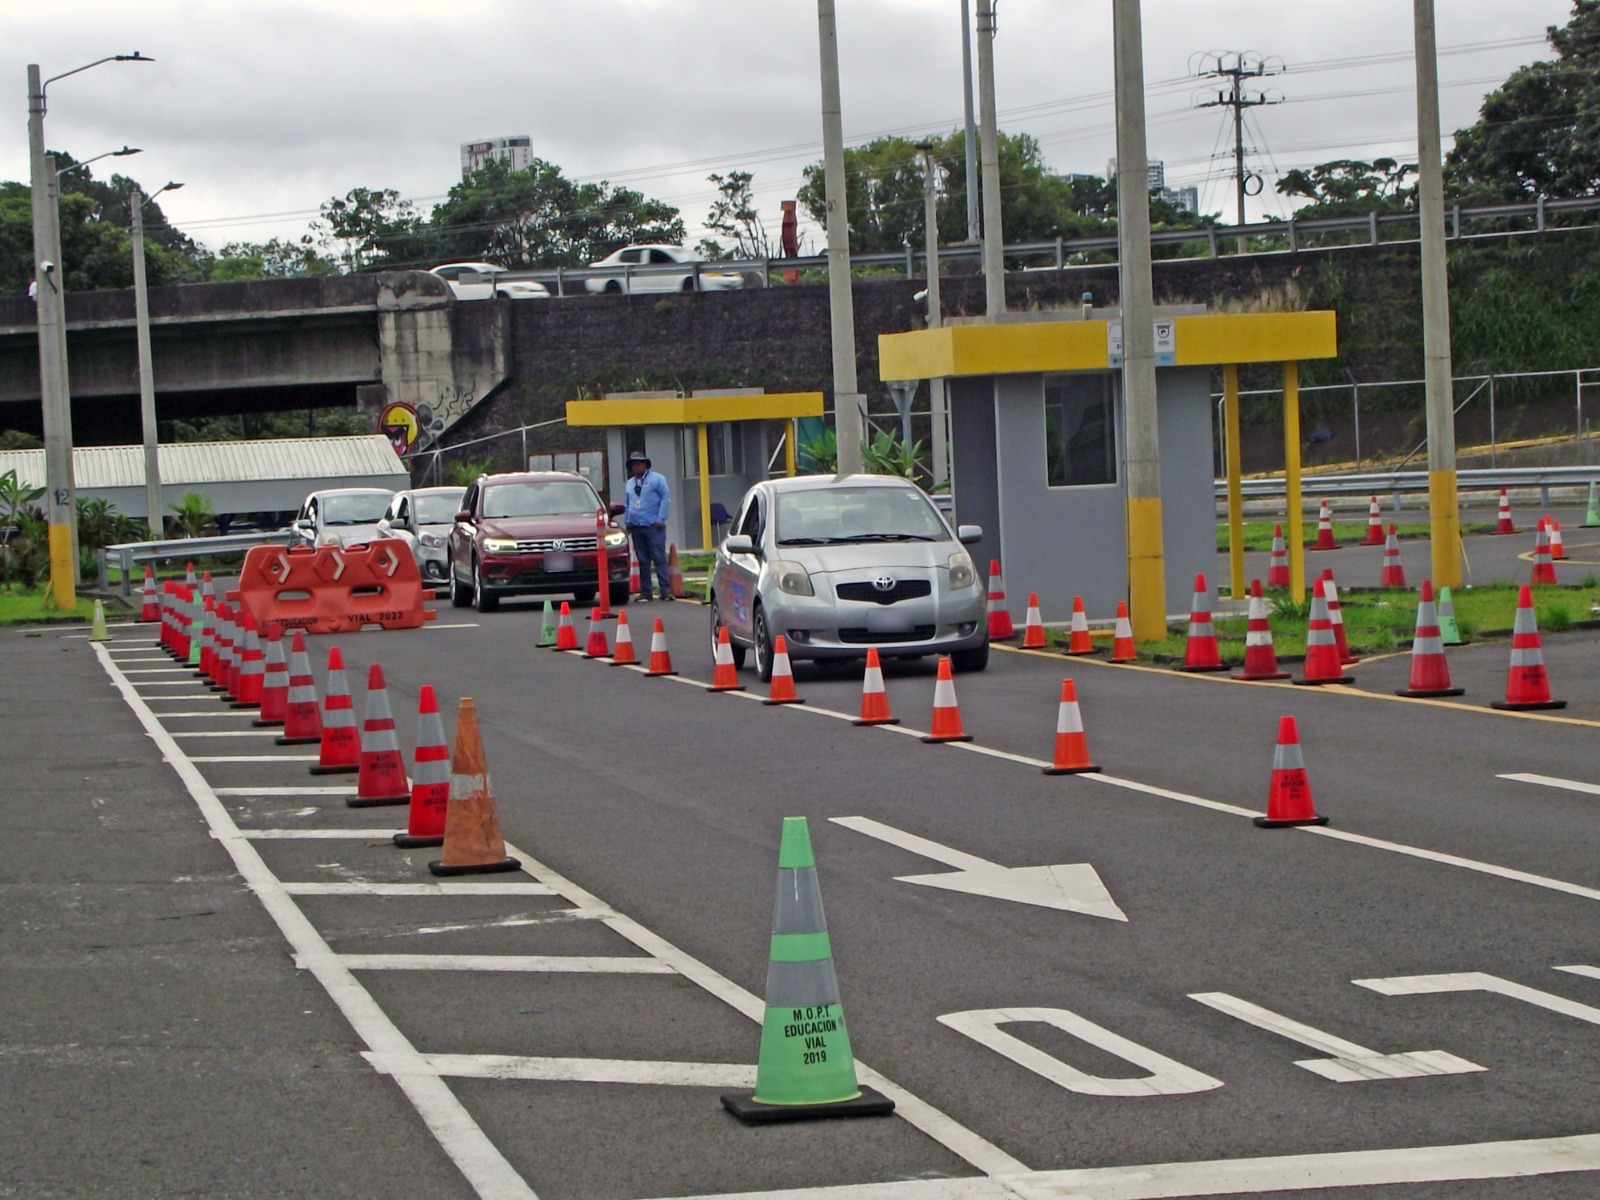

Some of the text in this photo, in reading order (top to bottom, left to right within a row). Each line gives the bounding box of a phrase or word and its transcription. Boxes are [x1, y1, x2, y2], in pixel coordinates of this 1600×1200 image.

[54, 488, 69, 506] 12
[281, 616, 318, 627] EDUCACION
[347, 614, 372, 623] VIAL
[379, 611, 404, 621] 2022
[784, 1019, 837, 1037] EDUCACION
[805, 1036, 827, 1049] VIAL
[804, 1051, 827, 1064] 2019
